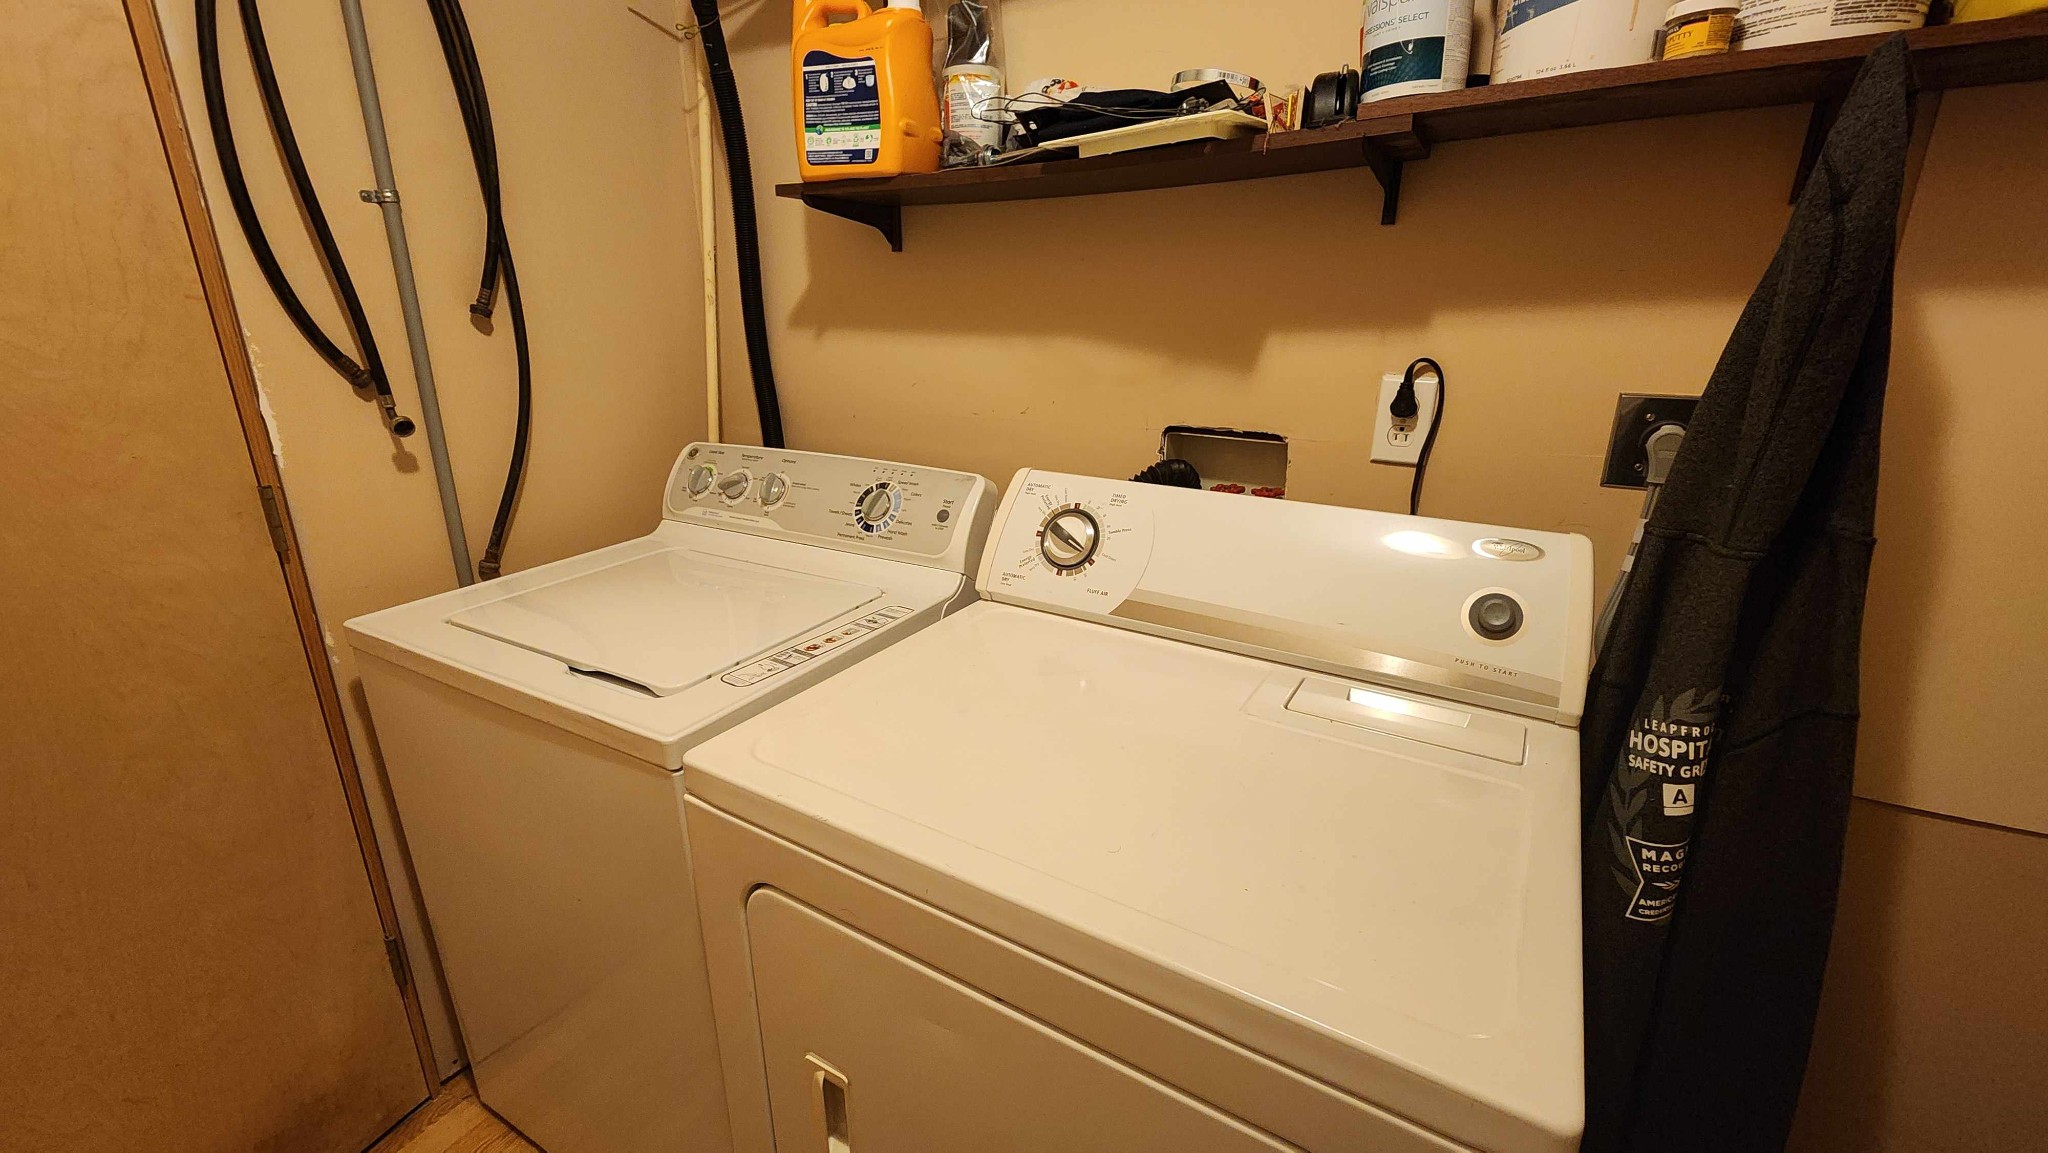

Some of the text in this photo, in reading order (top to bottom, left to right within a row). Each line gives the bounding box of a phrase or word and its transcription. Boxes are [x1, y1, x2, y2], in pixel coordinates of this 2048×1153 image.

[1398, 11, 1430, 24] SELECT
[1027, 482, 1052, 490] AUTOMATIC
[1110, 497, 1129, 505] DRYING
[1002, 571, 1026, 581] AUTOMATIC
[1086, 587, 1100, 595] FLUFF
[1455, 657, 1518, 678] PUSH TO START
[1629, 729, 1713, 761] HOSPIT
[1628, 754, 1675, 778] SAFETY
[1672, 788, 1688, 805] A
[1641, 846, 1688, 862] MAG
